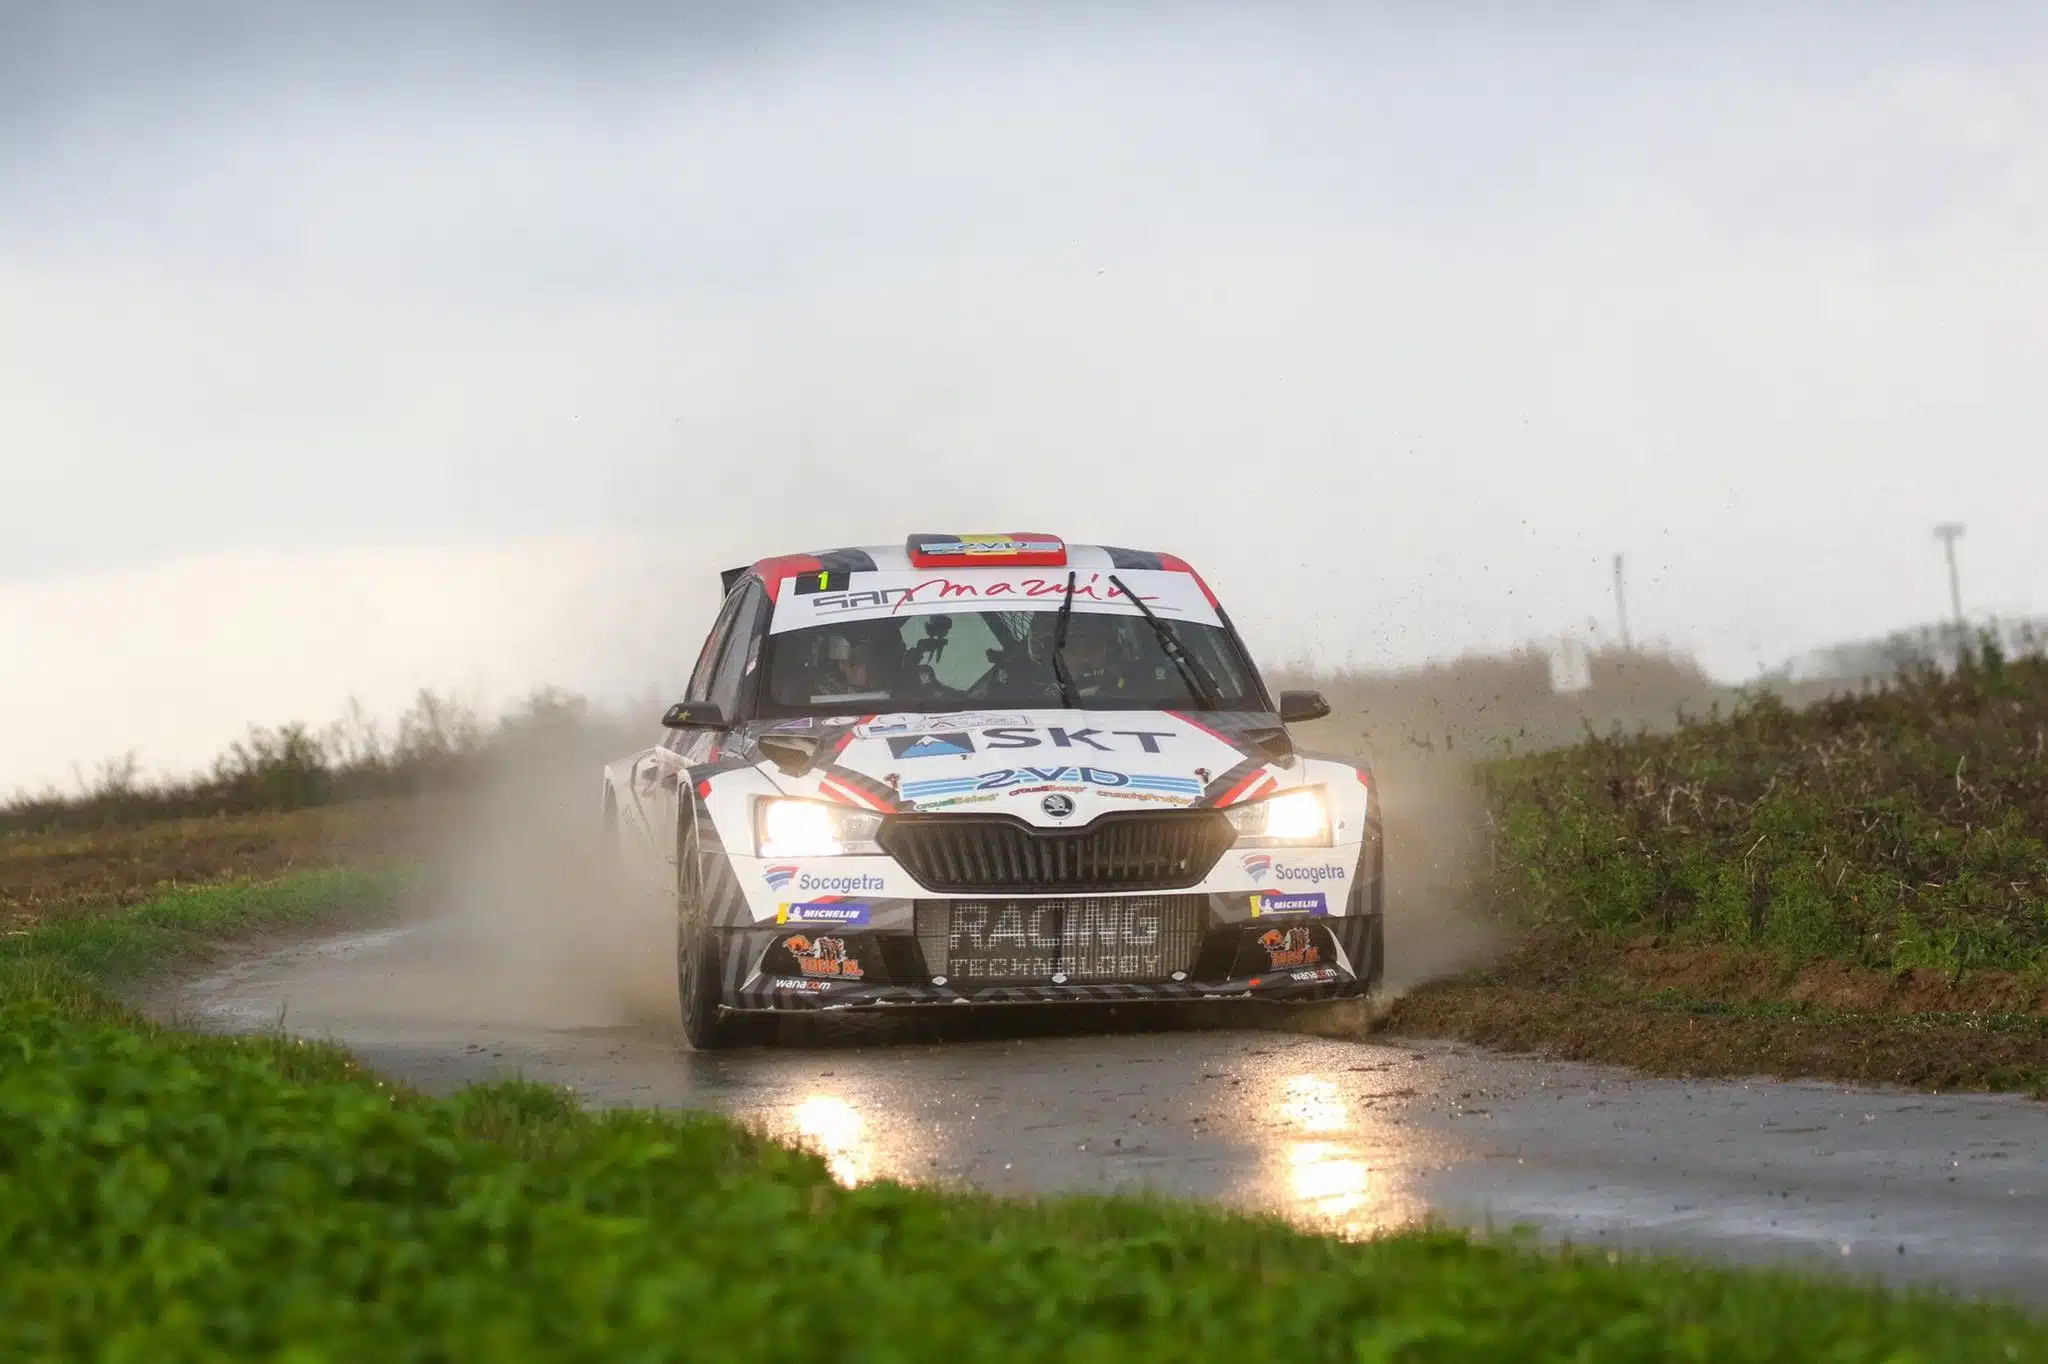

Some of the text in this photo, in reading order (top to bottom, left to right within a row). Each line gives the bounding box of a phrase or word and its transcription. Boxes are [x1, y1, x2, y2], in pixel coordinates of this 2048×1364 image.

[817, 571, 829, 591] 1
[982, 727, 1177, 753] SKT
[975, 766, 1130, 790] 2VD
[799, 874, 884, 893] Socogetra
[1275, 864, 1345, 883] Socogetra
[803, 909, 861, 919] MICHELIN
[1274, 899, 1319, 910] MICHELIN
[950, 899, 1161, 949] RACING
[950, 955, 1161, 977] TECHNOLOGY
